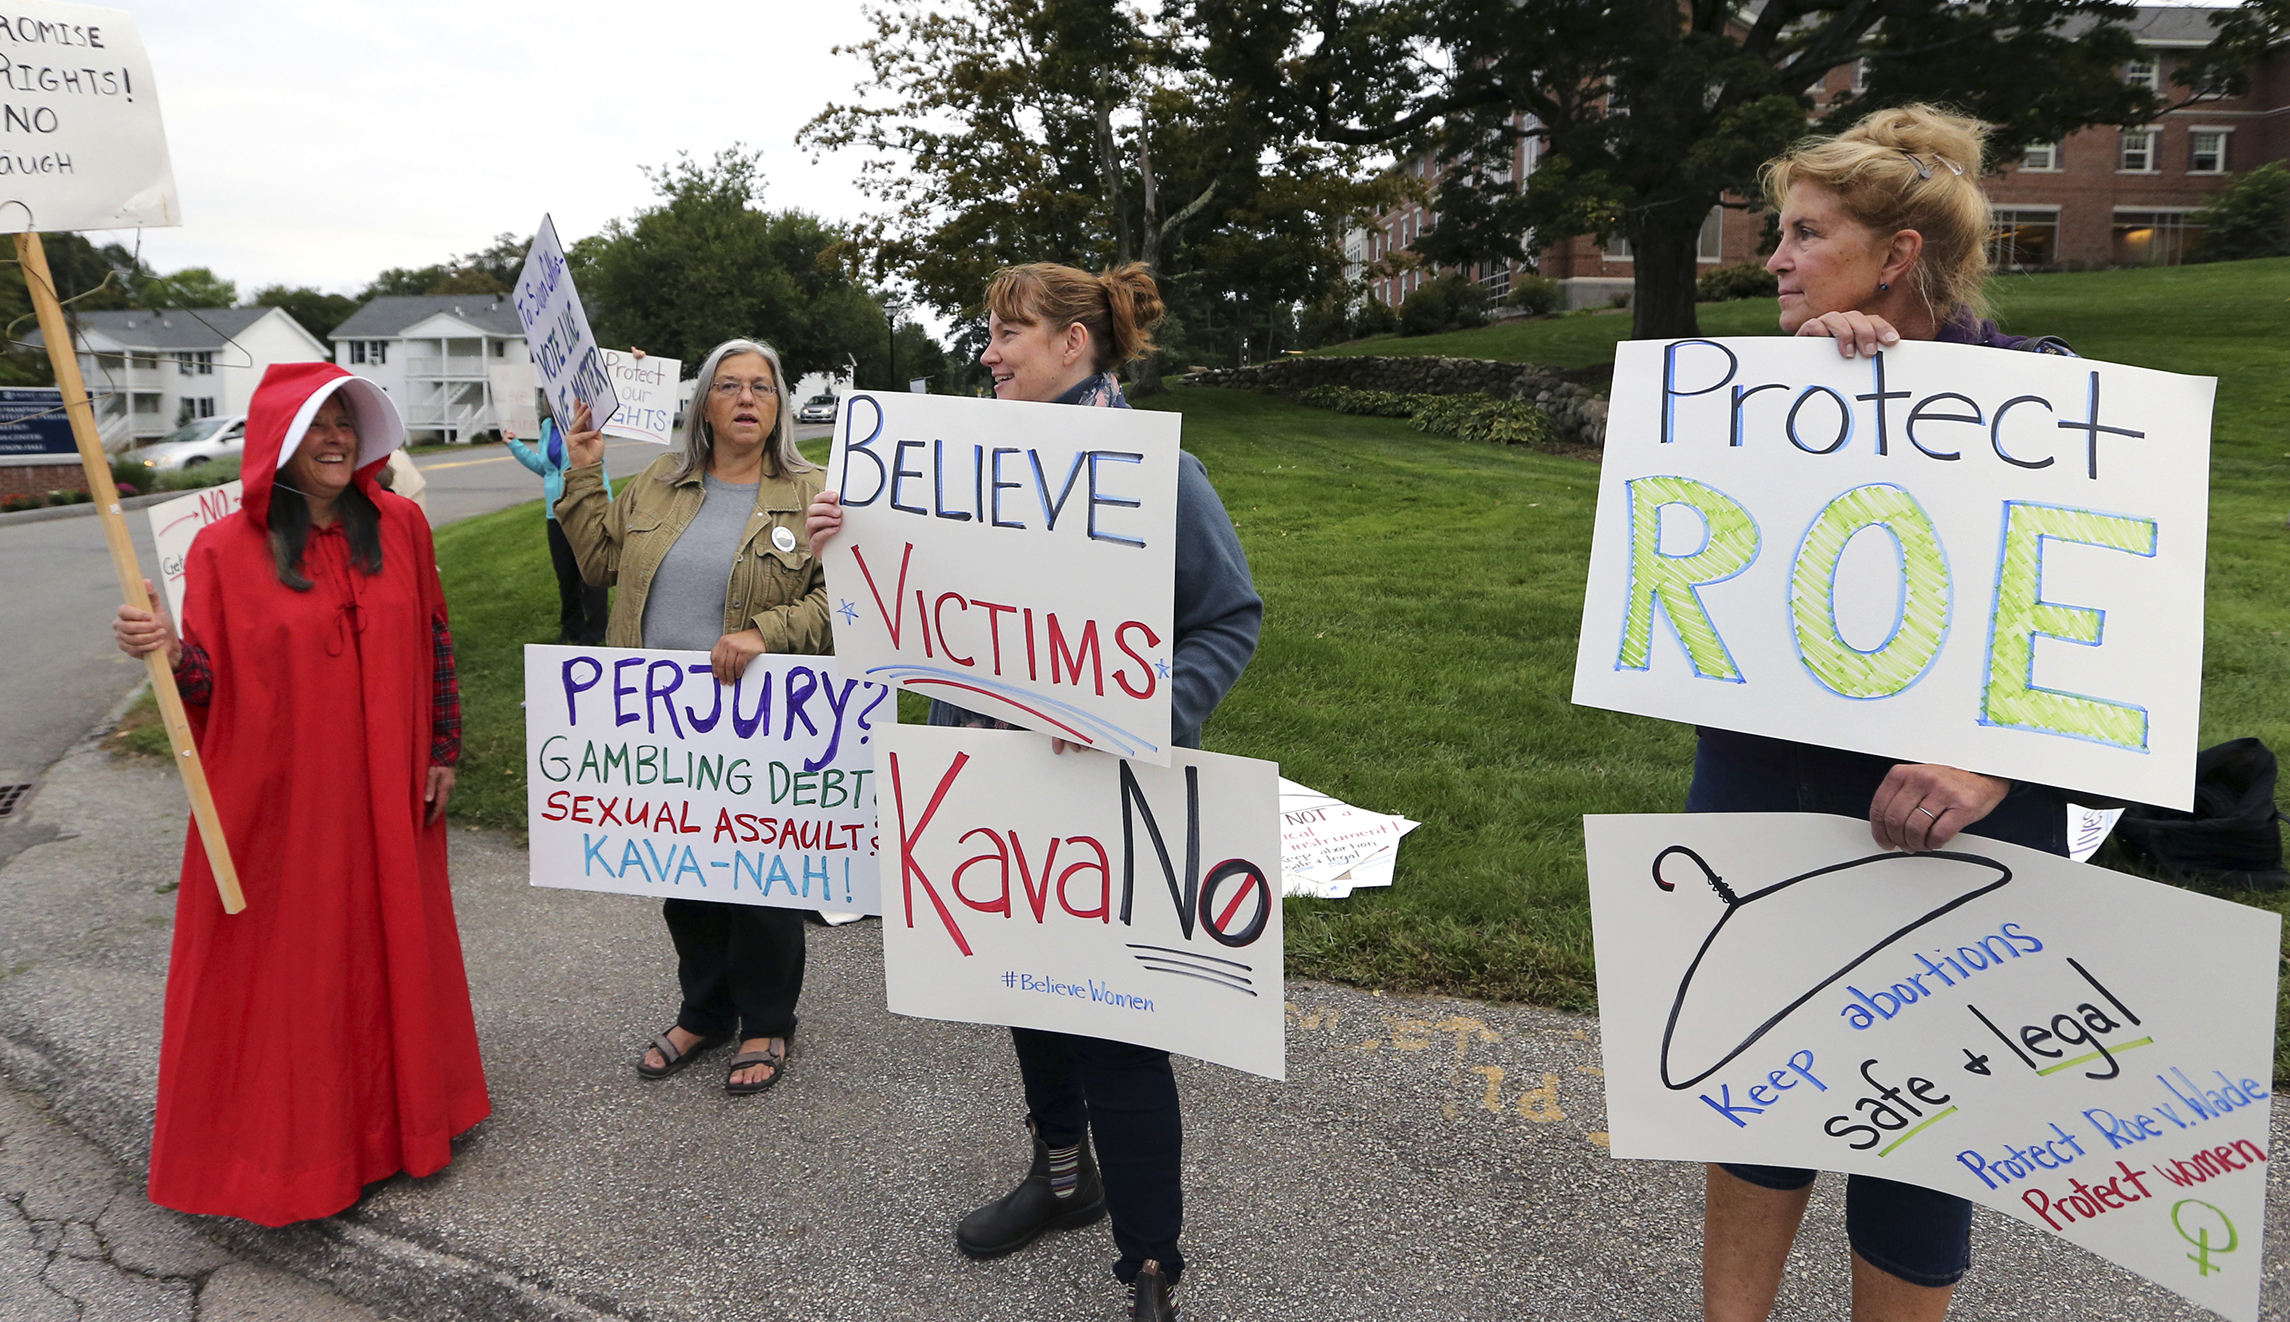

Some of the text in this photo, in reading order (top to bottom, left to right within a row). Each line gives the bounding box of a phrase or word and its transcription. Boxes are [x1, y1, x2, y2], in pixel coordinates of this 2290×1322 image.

[4, 104, 58, 133] NO
[536, 300, 580, 384] VOTE LIKE
[606, 351, 666, 386] Protect
[570, 346, 608, 411] MATTER
[621, 386, 653, 402] our
[1661, 340, 2146, 480] Protect
[839, 394, 1147, 549] BELIEVE
[851, 542, 1161, 700] VICTIMS
[1614, 474, 2158, 754] ROE
[540, 735, 752, 795] GAMBLING
[541, 790, 701, 834] SEXUAL
[1284, 808, 1327, 825] NOT
[584, 833, 853, 904] KAVA-NAH!
[1320, 841, 1377, 855] abortion
[1326, 850, 1360, 864] legal
[1700, 1049, 1828, 1128] Keep
[1841, 922, 2044, 1031] abortions
[1824, 1059, 1951, 1150] safe
[1968, 957, 2141, 1080] legal
[1956, 1122, 2086, 1190] Protect
[2081, 1107, 2163, 1150] Roe
[2021, 1138, 2267, 1232] Protect women
